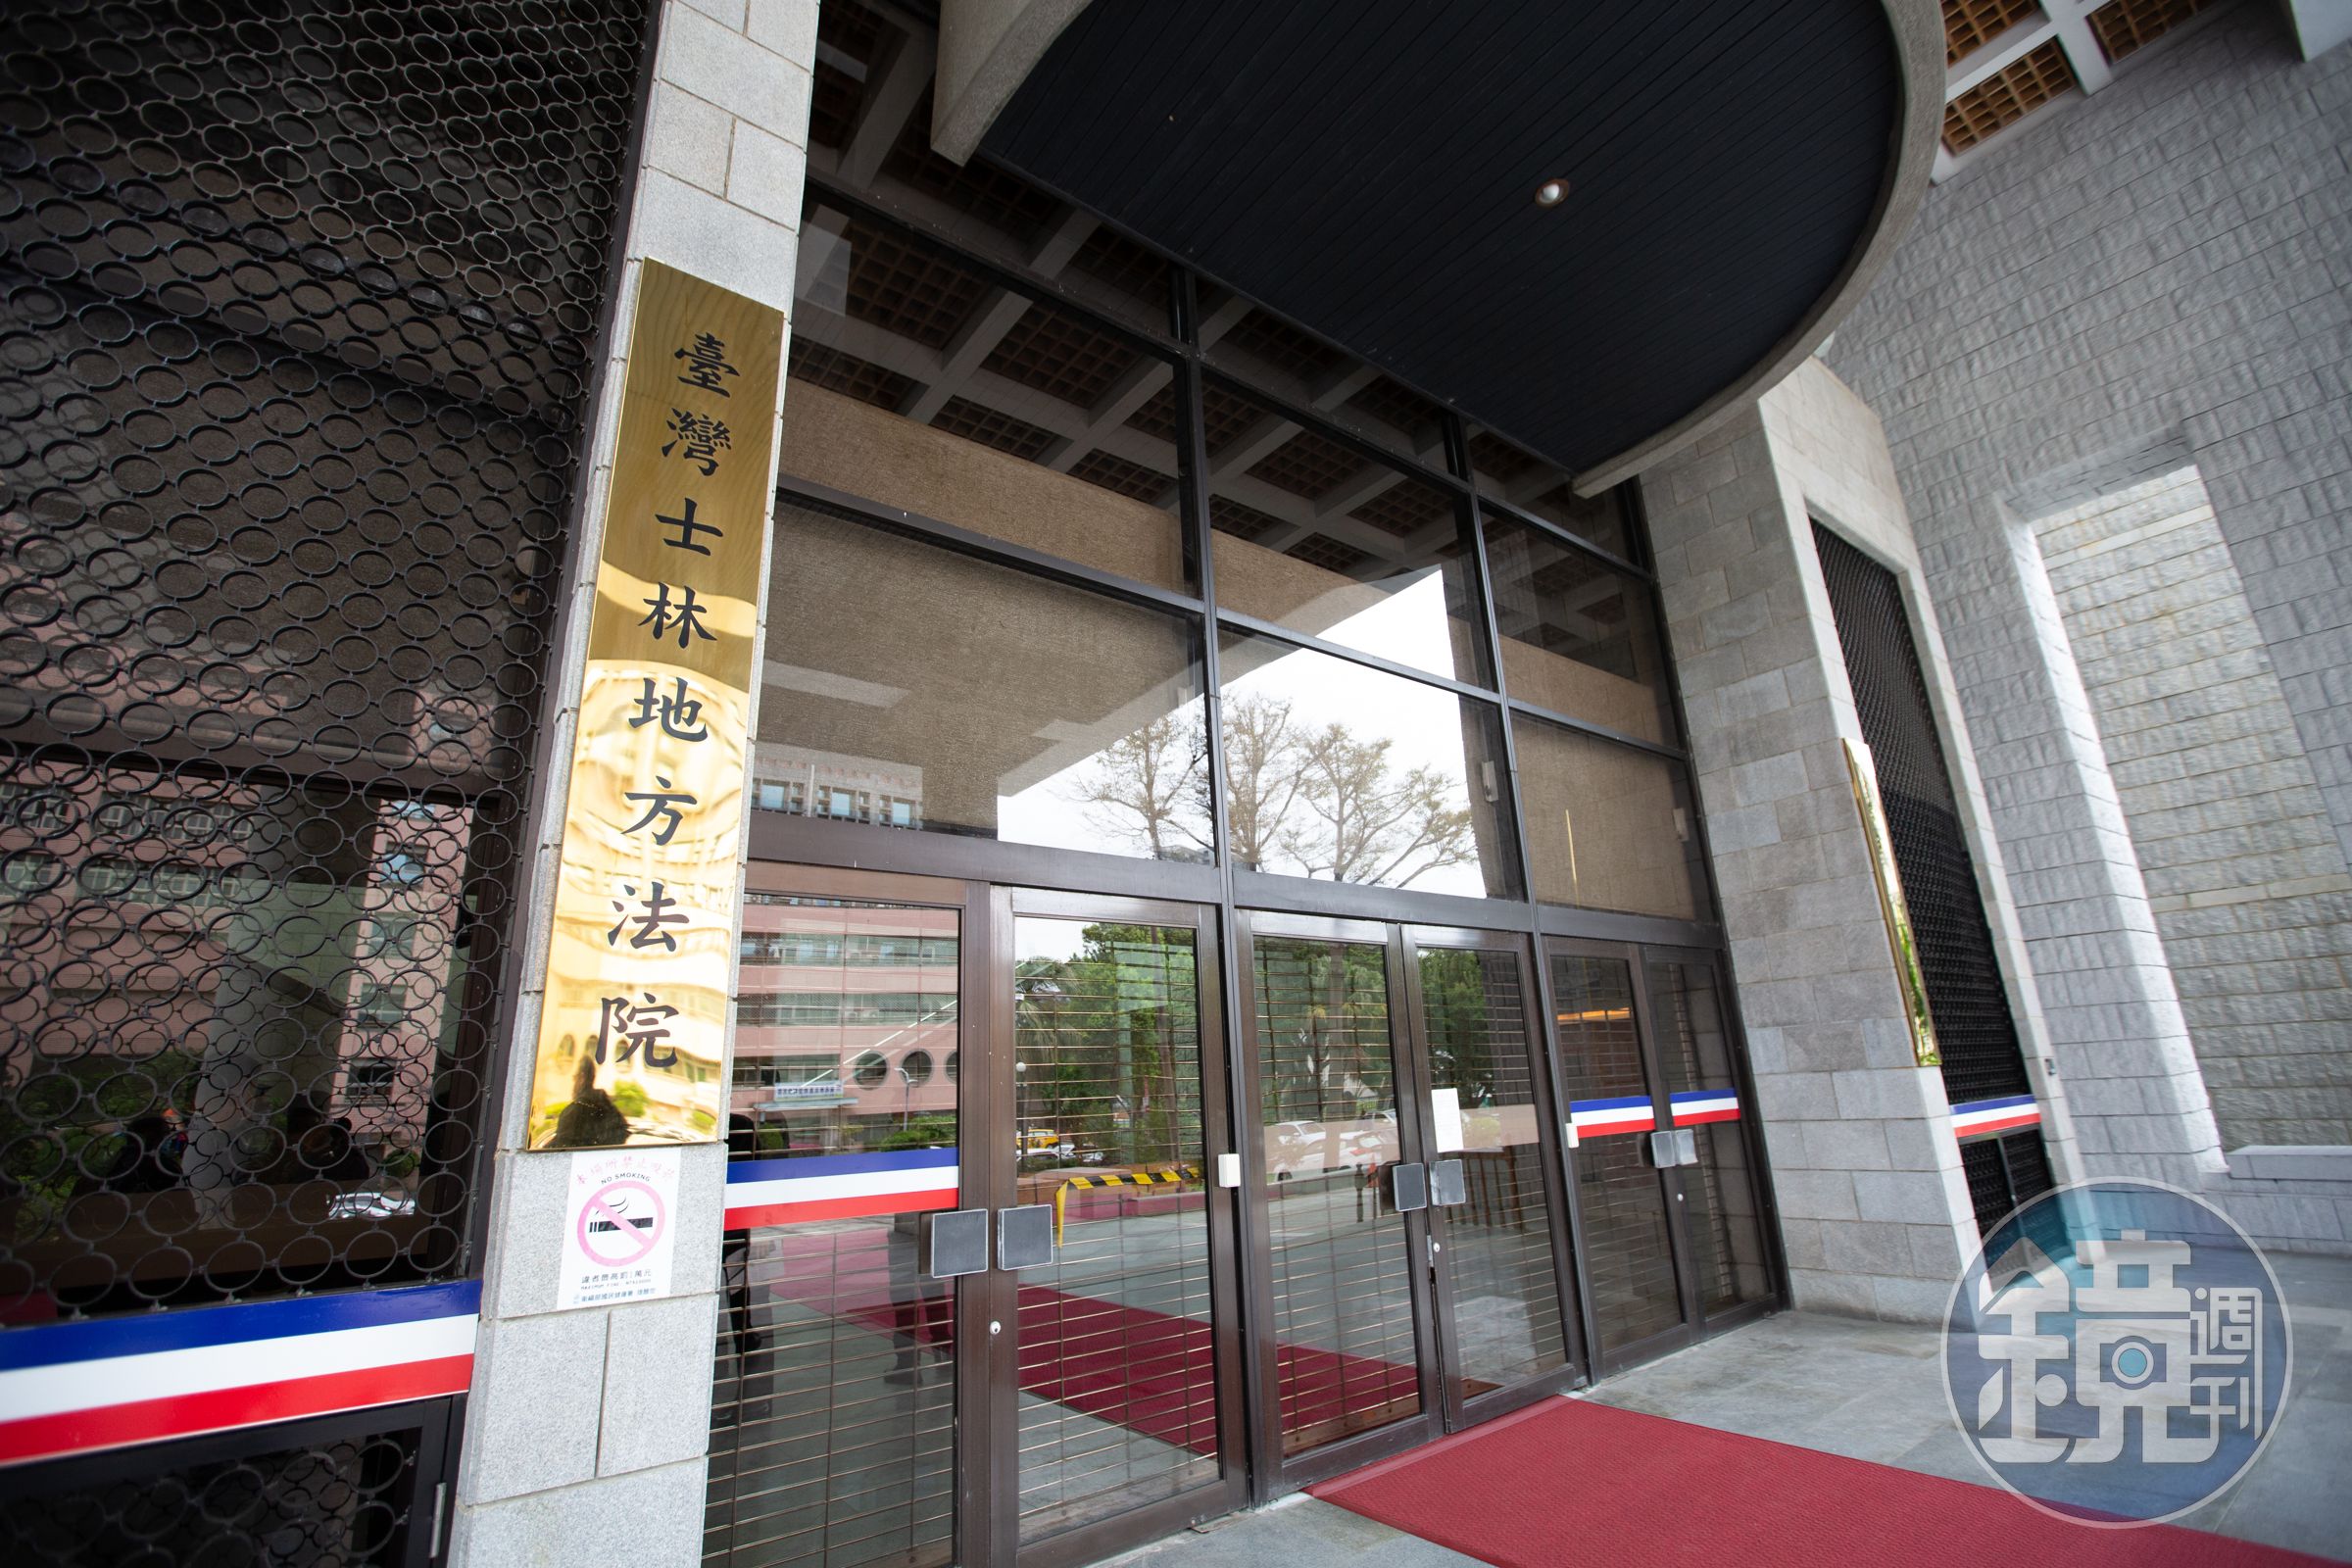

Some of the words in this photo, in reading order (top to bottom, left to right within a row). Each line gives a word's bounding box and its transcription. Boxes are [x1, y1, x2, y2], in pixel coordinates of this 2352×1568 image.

[595, 332, 741, 1068] 臺灣士林地方法院
[601, 1176, 612, 1185] NO
[614, 1172, 651, 1182] SMOKING
